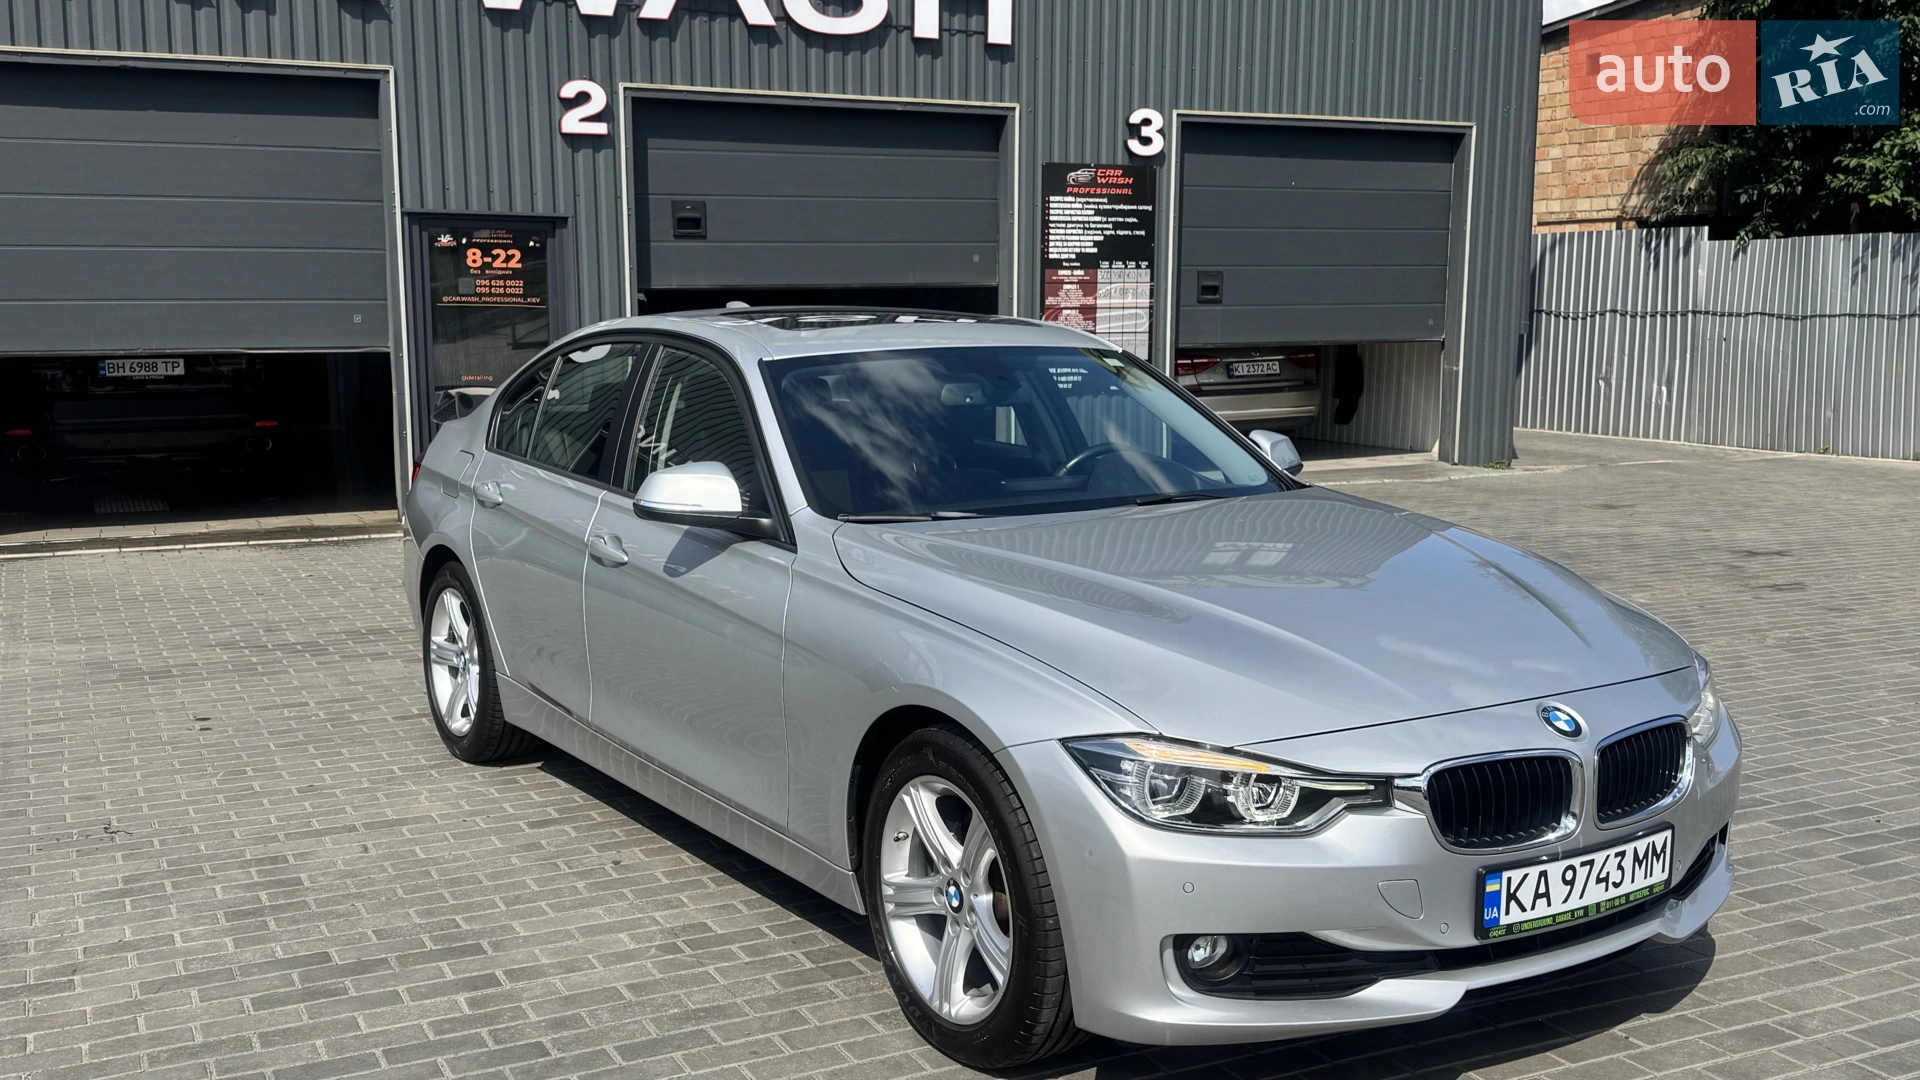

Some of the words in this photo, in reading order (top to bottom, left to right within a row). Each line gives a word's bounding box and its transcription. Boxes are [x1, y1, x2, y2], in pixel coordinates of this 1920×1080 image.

[558, 79, 608, 135] 2
[1127, 108, 1164, 157] 3
[1097, 169, 1123, 177] CAR
[1097, 177, 1134, 185] WASH
[1066, 187, 1133, 195] PROFESSIONAL
[466, 247, 522, 268] 8-22
[505, 279, 524, 287] 0022
[107, 362, 126, 374] BH
[129, 362, 159, 374] 6988
[161, 360, 181, 373] TP
[1246, 363, 1265, 374] 2372
[1266, 362, 1278, 373] AC
[1504, 869, 1552, 916] KA
[1560, 849, 1627, 905] 9743
[1630, 835, 1668, 885] MM
[1484, 906, 1499, 920] UA
